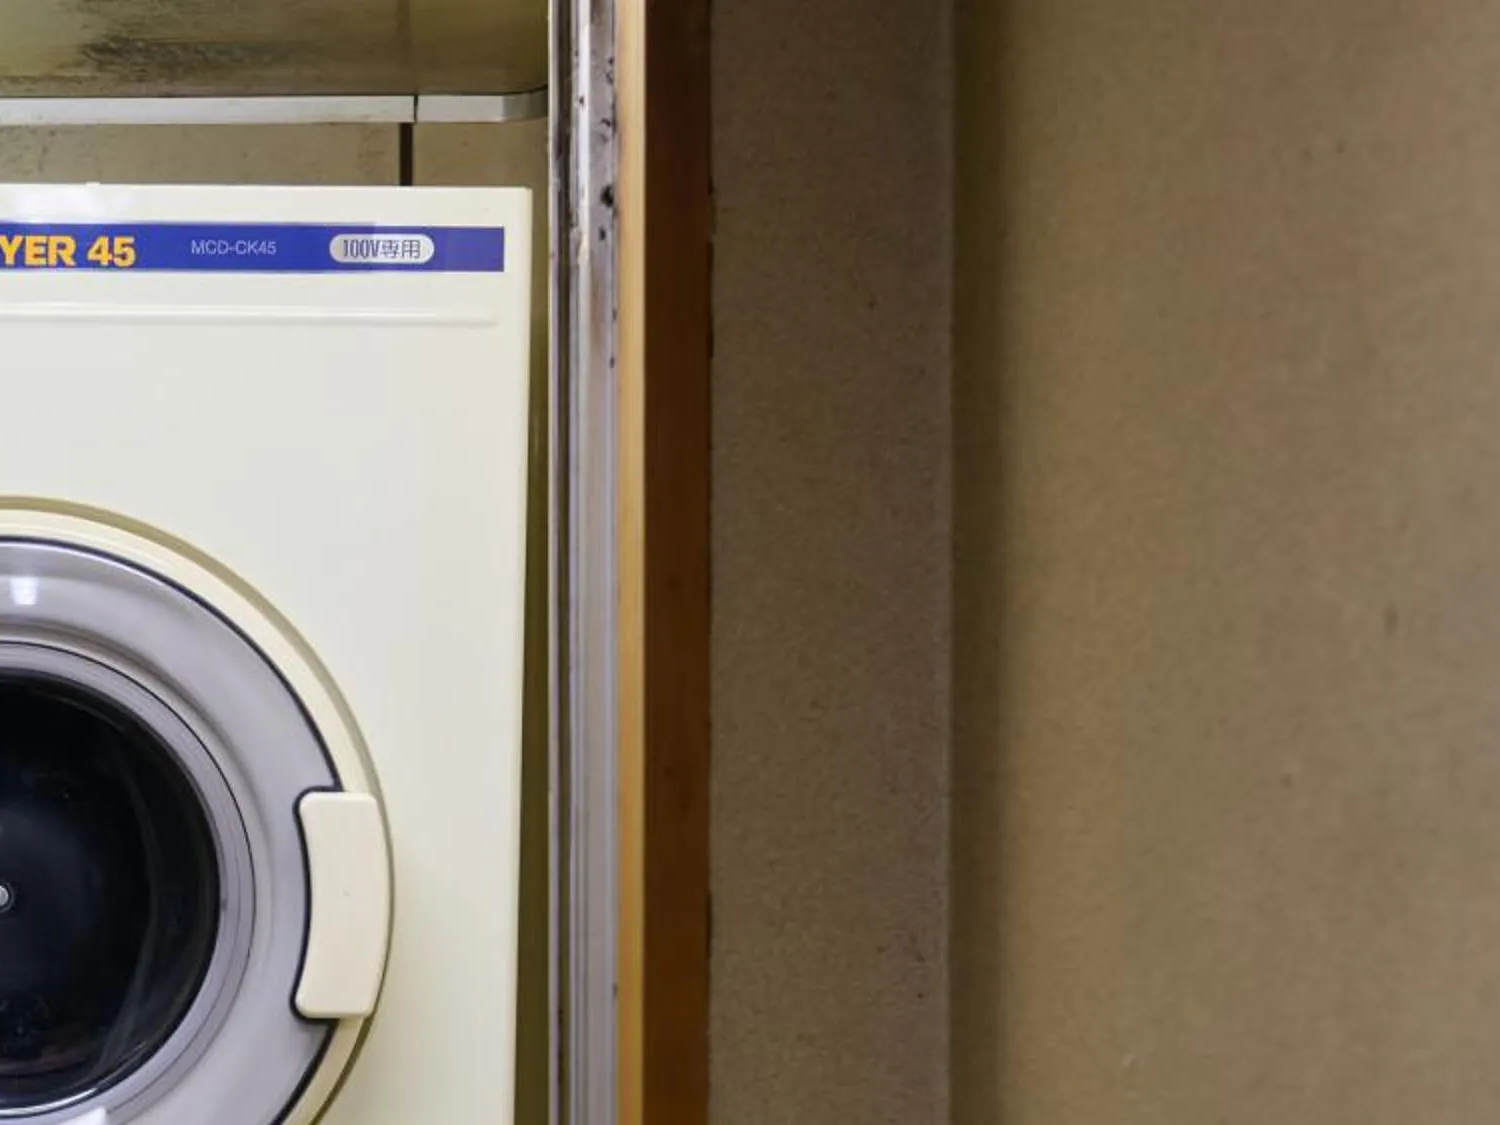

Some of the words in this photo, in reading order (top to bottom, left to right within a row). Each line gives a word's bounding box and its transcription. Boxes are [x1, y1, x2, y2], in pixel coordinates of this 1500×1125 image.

[86, 236, 136, 267] 45
[191, 239, 277, 255] MCD-CK45
[343, 239, 421, 259] 100V専用
